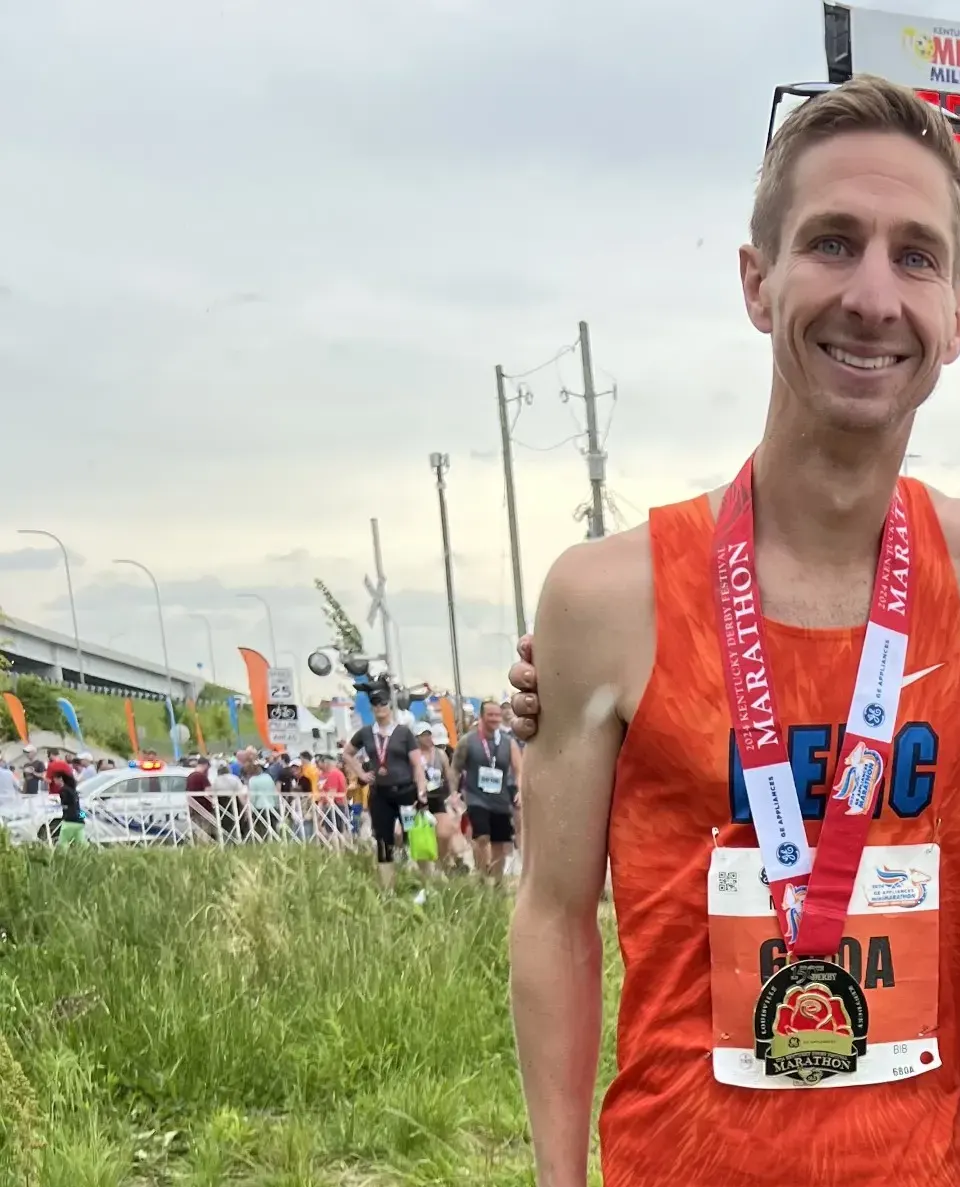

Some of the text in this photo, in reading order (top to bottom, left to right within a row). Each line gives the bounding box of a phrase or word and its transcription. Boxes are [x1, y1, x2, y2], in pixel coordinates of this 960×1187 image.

[718, 546, 731, 603] FESTIVAL
[724, 604, 737, 647] DERBY
[728, 541, 780, 750] MARATHON
[878, 638, 890, 687] APPLIANCES
[271, 685, 292, 698] 25
[729, 651, 750, 722] KENTUCKY
[769, 775, 785, 825] APPLIANCES
[858, 762, 874, 808] MARATHON
[761, 985, 777, 1035] LOUISVILLE
[848, 985, 864, 1028] KENTUCKY
[773, 1056, 851, 1073] MARATHON
[893, 1044, 908, 1054] BIB
